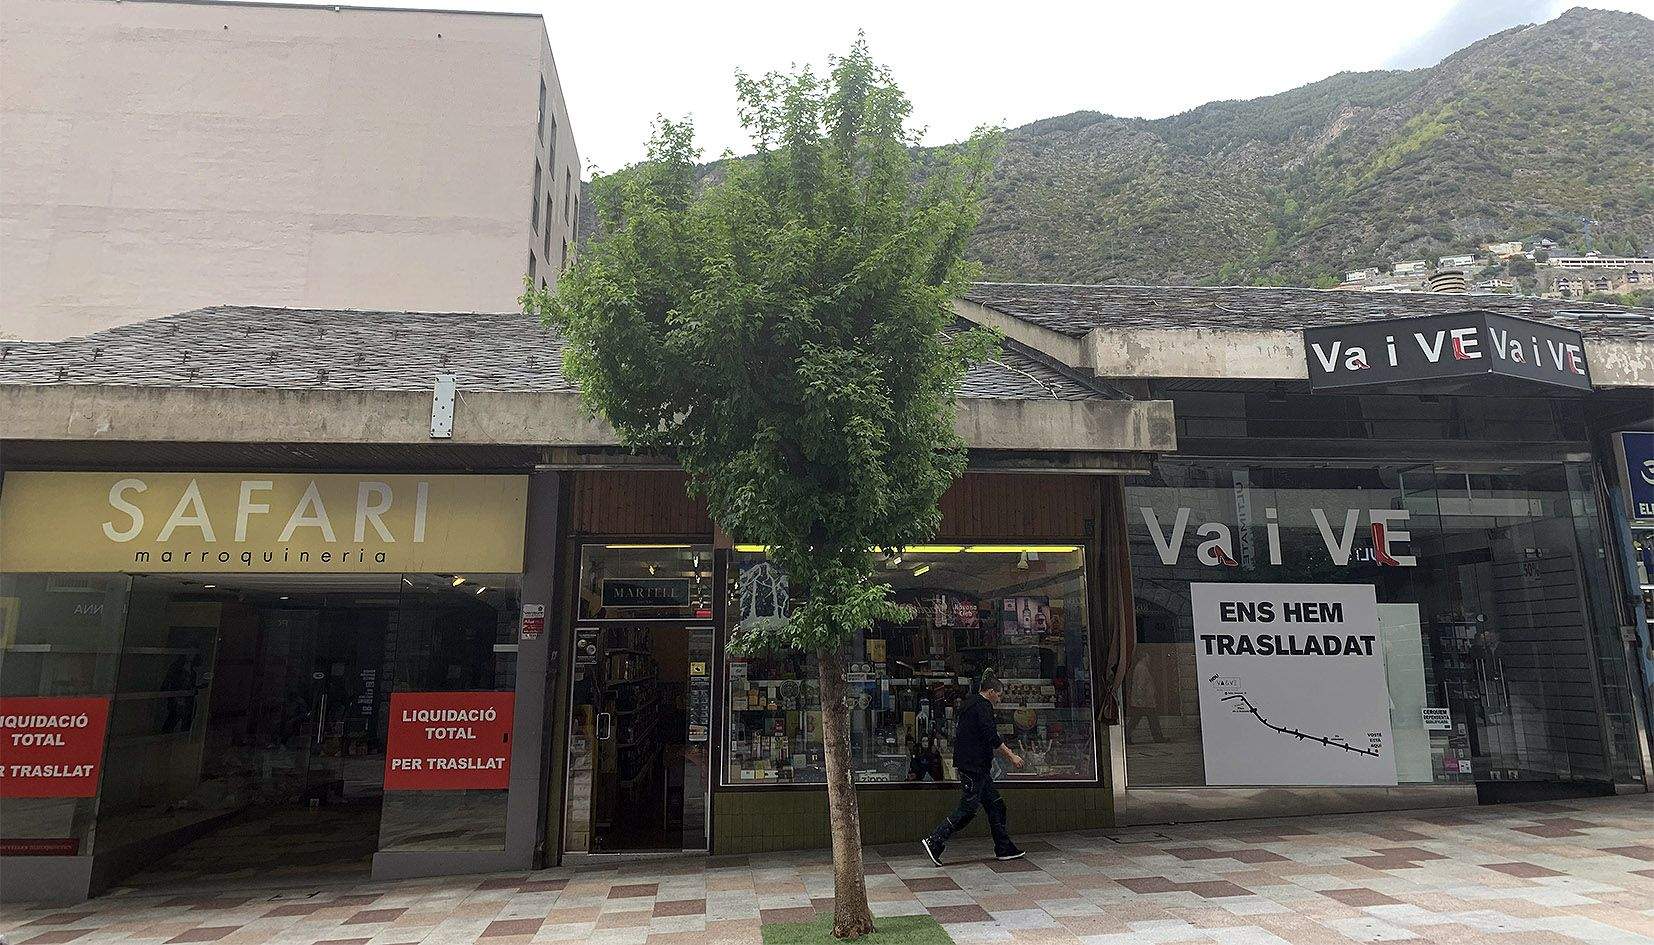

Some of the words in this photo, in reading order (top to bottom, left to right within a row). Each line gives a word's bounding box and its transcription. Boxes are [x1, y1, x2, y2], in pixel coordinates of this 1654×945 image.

[1311, 341, 1370, 373] Va
[1386, 335, 1398, 366] i
[1414, 327, 1482, 363] VE
[1489, 327, 1526, 364] Va
[1530, 336, 1542, 367] i
[1547, 339, 1586, 376] VE
[102, 478, 429, 543] SAFARI
[1139, 507, 1239, 566] Va
[1265, 507, 1282, 565] i
[1310, 508, 1417, 566] VE
[135, 548, 386, 566] marroquineria
[613, 587, 678, 598] MARTELL
[1220, 602, 1275, 622] ENS
[1283, 602, 1344, 622] HEM
[1200, 635, 1375, 656] TRASLLADAT
[0, 713, 88, 728] IQUIDACIÓ
[402, 706, 497, 722] LIQUIDACIÓ
[11, 734, 65, 746] TOTAL
[425, 728, 477, 740] TOTAL
[10, 765, 94, 777] TRASLLAT
[391, 758, 422, 770] PER
[427, 757, 506, 770] TRASLLAT
